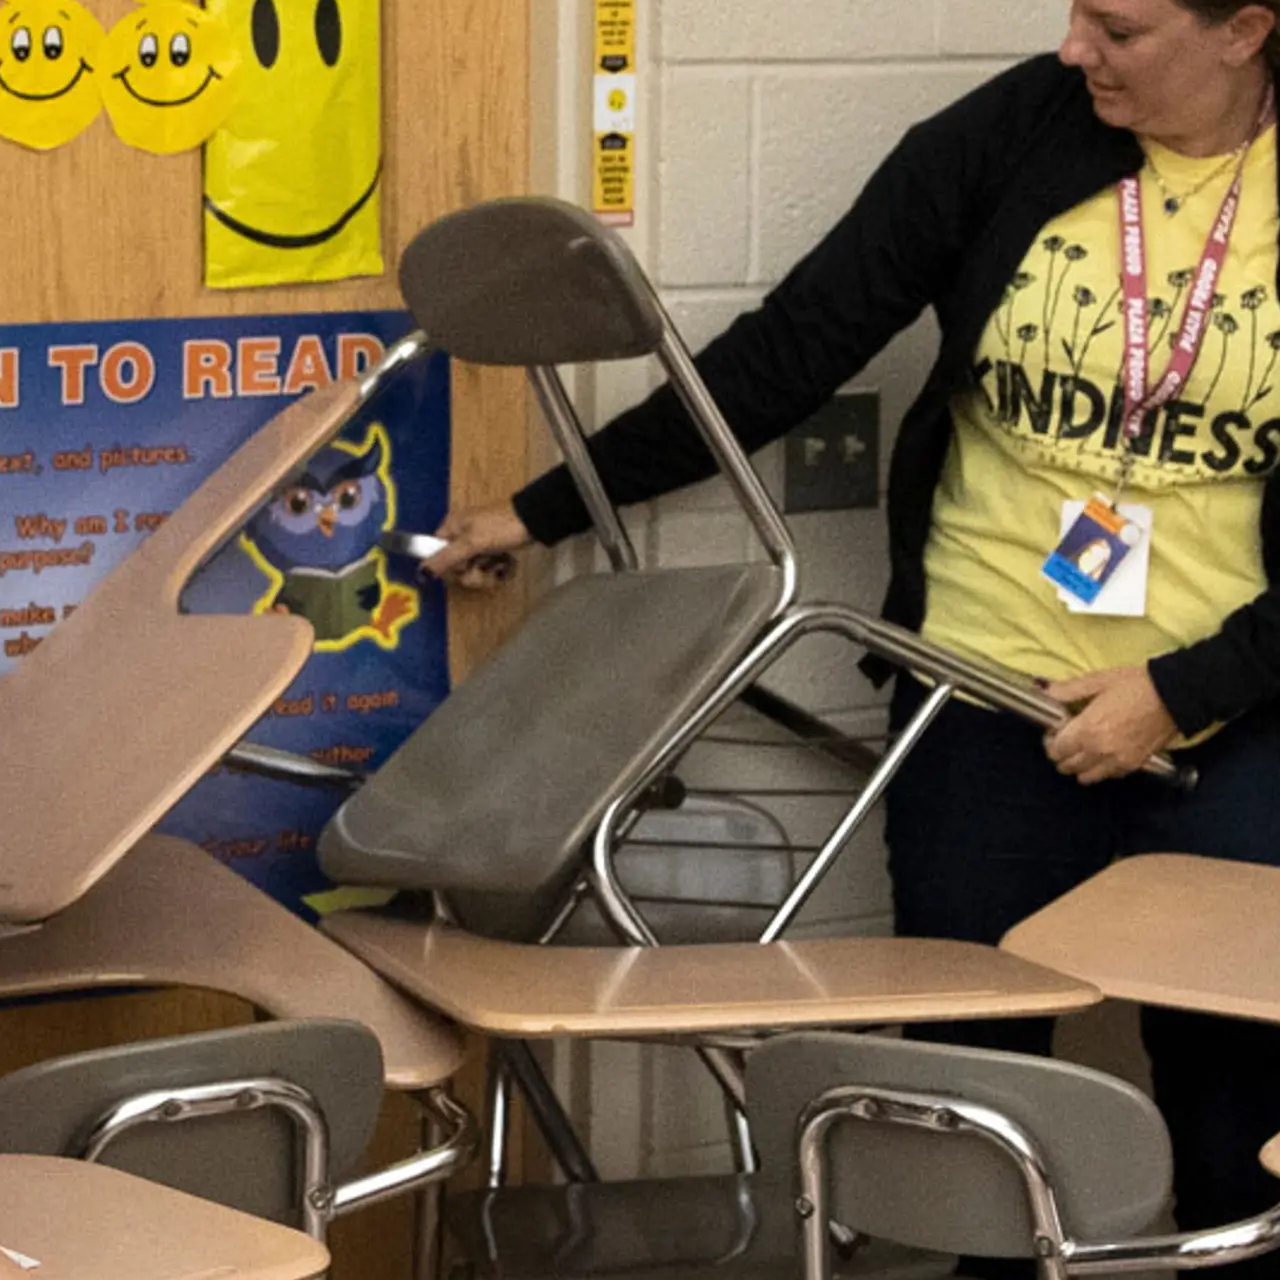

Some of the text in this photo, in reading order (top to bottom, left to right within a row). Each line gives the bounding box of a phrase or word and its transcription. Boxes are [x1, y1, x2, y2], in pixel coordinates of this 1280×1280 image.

[47, 340, 156, 406] TO
[182, 332, 386, 400] READ
[52, 442, 94, 472] and
[15, 514, 68, 543] Why
[74, 515, 108, 537] am
[346, 691, 402, 715] again
